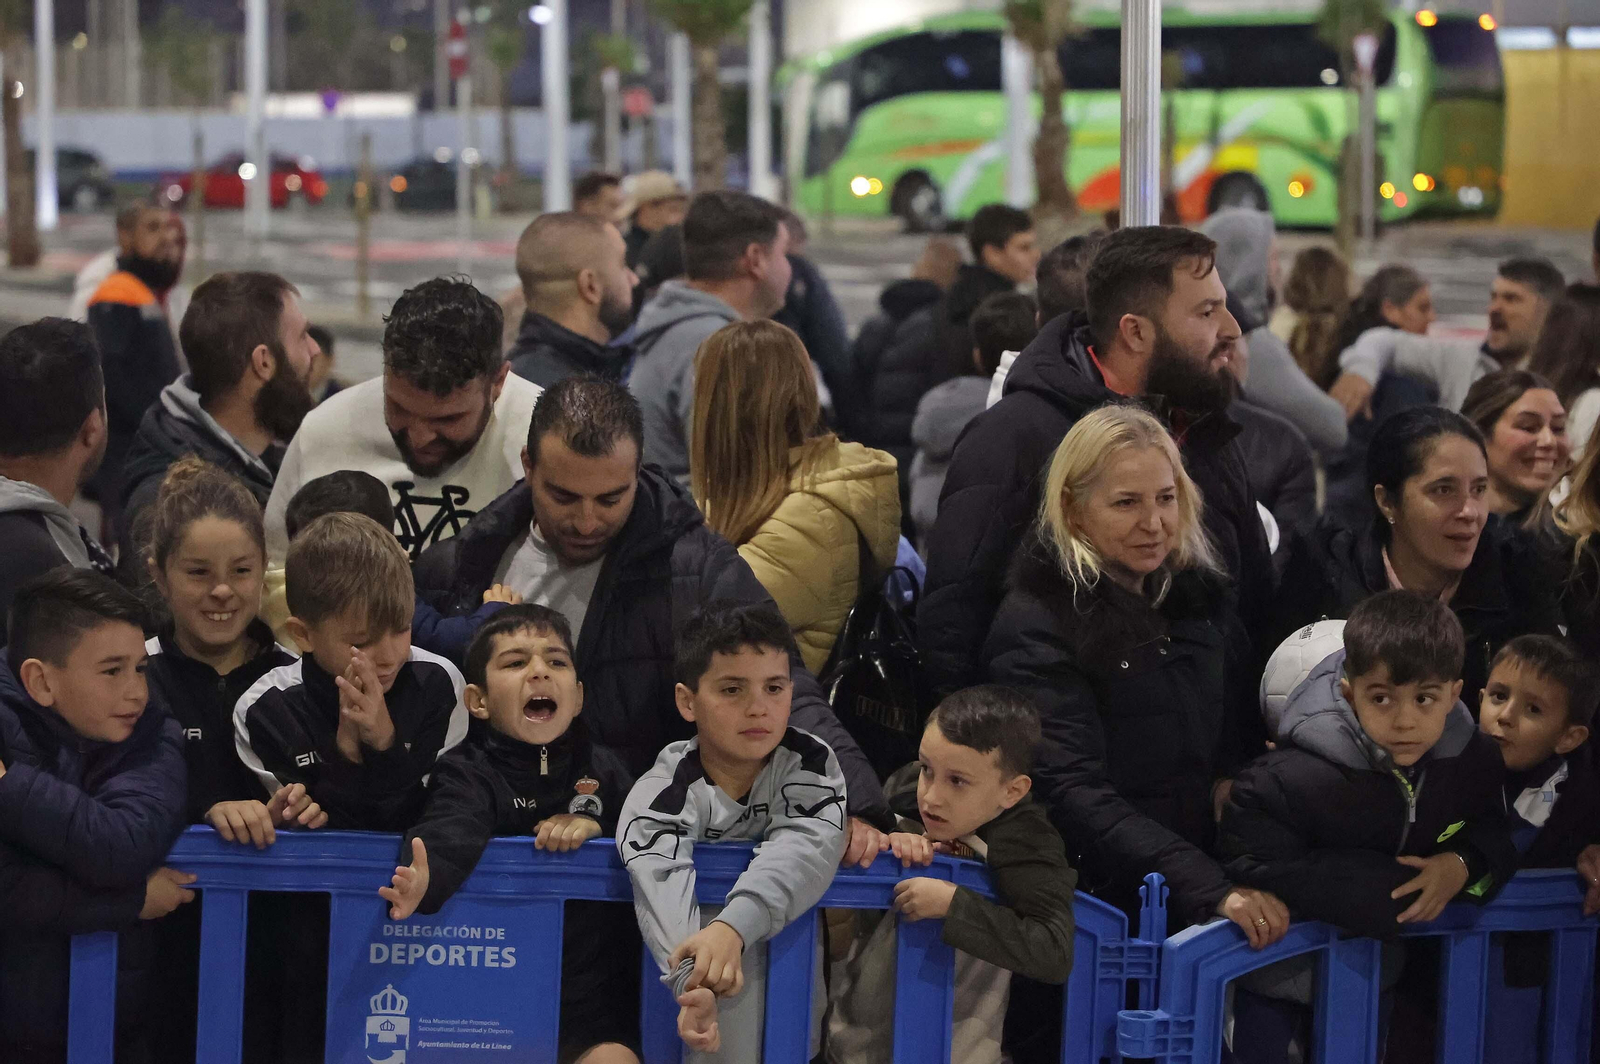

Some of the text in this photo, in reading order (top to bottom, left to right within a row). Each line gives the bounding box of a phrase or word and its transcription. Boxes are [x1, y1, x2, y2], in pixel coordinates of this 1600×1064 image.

[383, 924, 506, 940] DELEGACIÓN DE
[369, 942, 517, 968] DEPORTES
[488, 1027, 514, 1035] Deportes
[417, 1040, 470, 1049] Ayuntamiento
[481, 1042, 491, 1050] La
